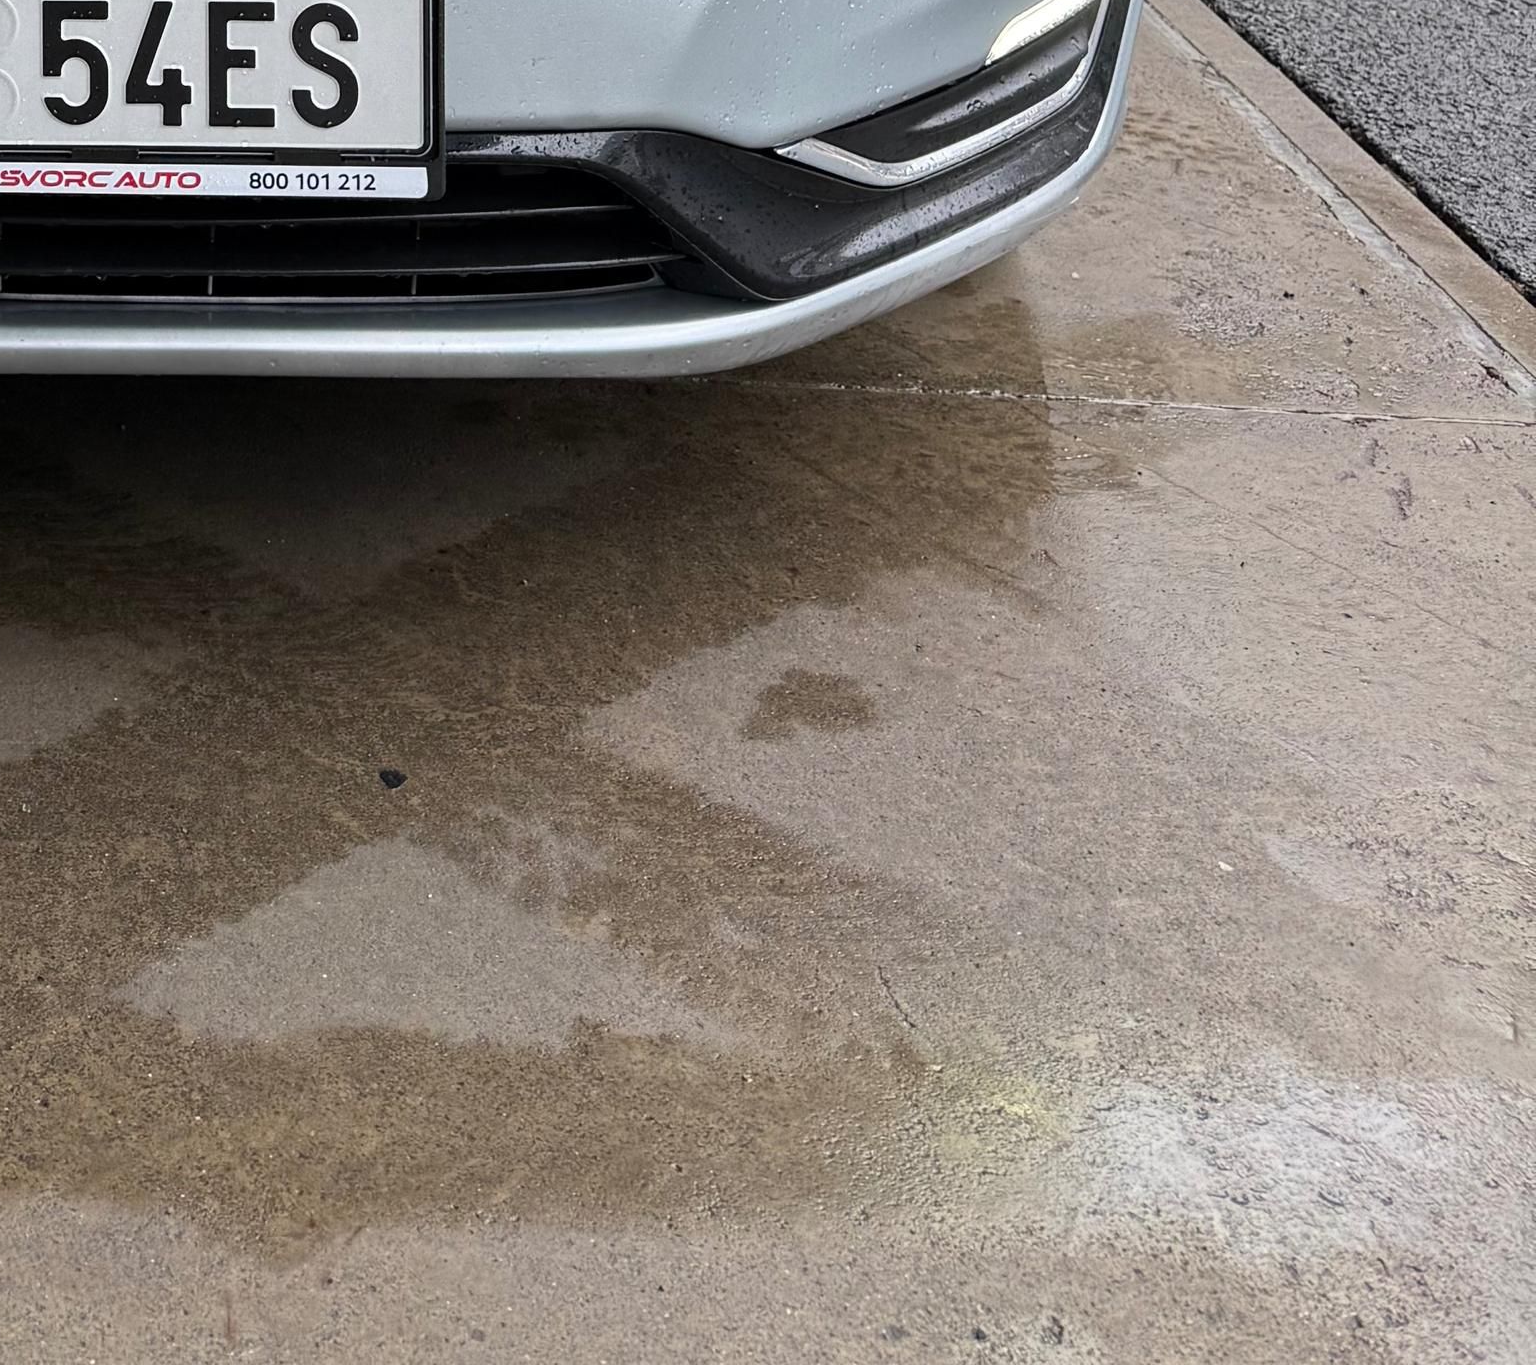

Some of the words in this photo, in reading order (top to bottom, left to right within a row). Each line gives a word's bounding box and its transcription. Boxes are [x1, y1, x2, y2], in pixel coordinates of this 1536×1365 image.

[42, 0, 359, 129] 54ES
[248, 172, 289, 190] 800
[295, 173, 330, 191] 101
[337, 173, 377, 192] 212
